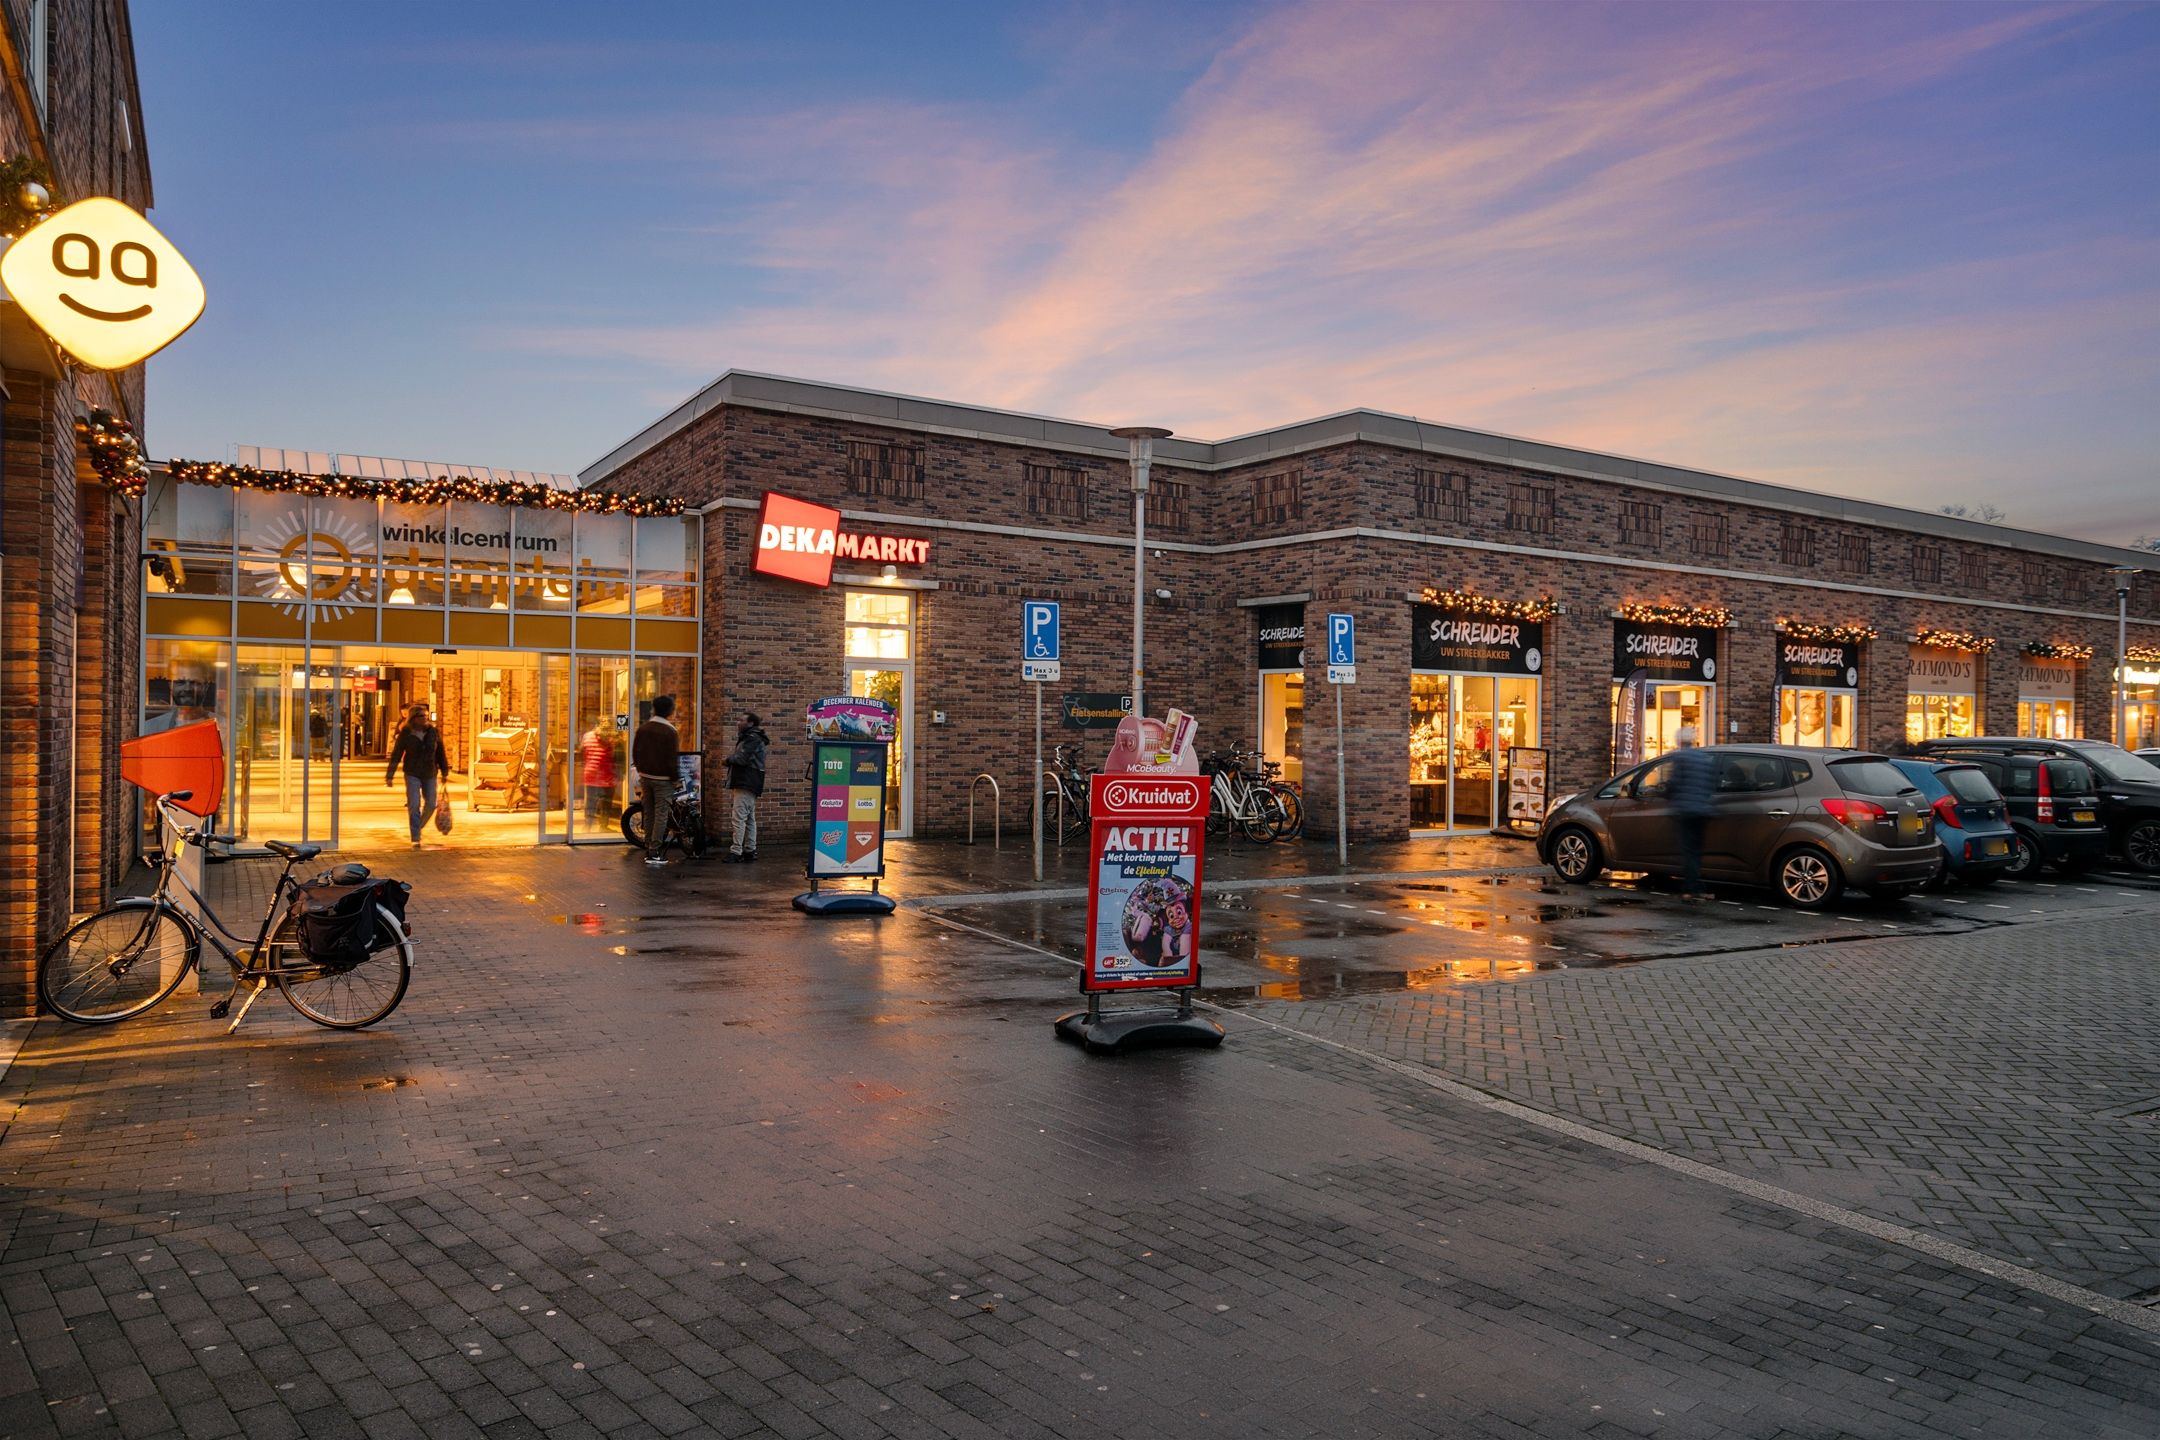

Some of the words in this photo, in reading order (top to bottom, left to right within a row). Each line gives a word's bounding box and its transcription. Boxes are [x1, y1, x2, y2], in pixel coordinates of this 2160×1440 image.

[383, 523, 558, 553] winkelcentrum
[279, 532, 625, 604] Ordenplein
[1032, 606, 1052, 636] P
[1335, 618, 1349, 644] P
[1260, 626, 1304, 641] SCHREUDE
[1430, 619, 1521, 649] SCHREUDER
[1440, 647, 1455, 657] UW
[1455, 648, 1511, 660] STREEKBAKKER
[1626, 633, 1699, 659] SCHREUDER
[1784, 644, 1844, 668] SCHREUDER
[1907, 659, 1972, 678] RAYMOND'S
[2018, 666, 2072, 684] RAYMOND'S
[823, 697, 854, 707] DECEMBER
[854, 698, 884, 708] KALENDER
[1623, 680, 1638, 759] SCHREUDER
[823, 760, 843, 770] TOTO
[1128, 787, 1191, 805] Kruidvat
[1104, 826, 1190, 853] ACTIE!
[1106, 853, 1123, 862] Met
[1124, 852, 1156, 864] korting
[1156, 854, 1178, 862] naar
[1124, 866, 1135, 875] de
[1135, 866, 1170, 878] Efteling!
